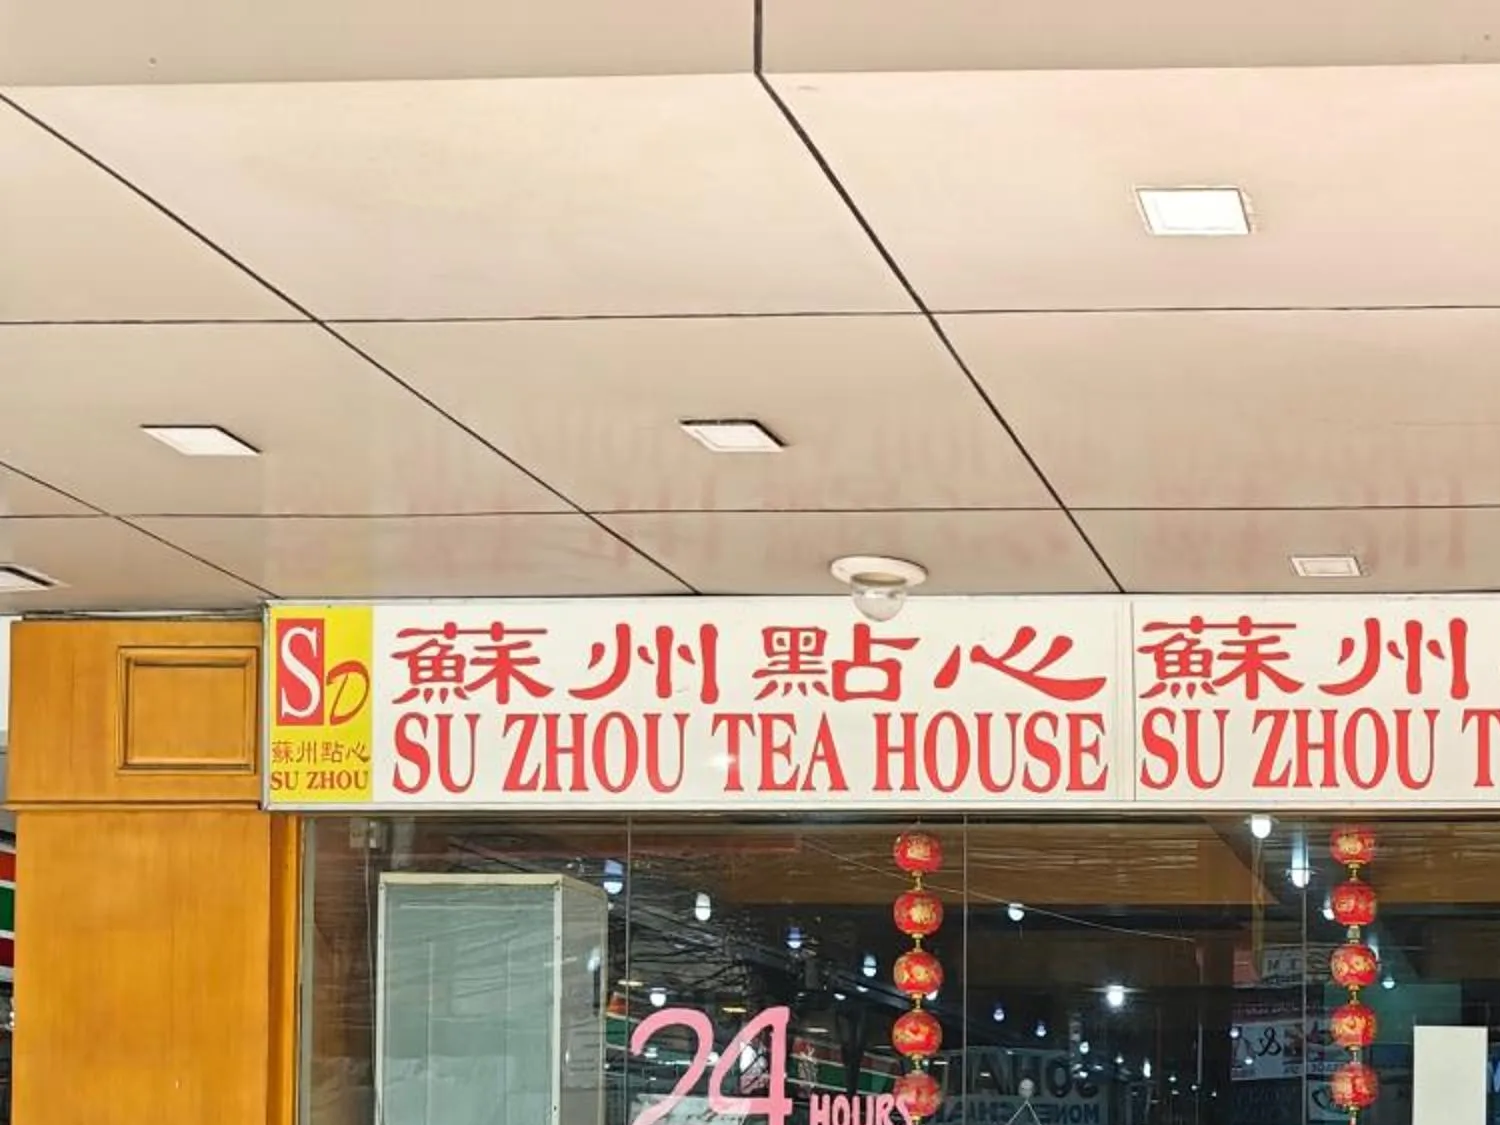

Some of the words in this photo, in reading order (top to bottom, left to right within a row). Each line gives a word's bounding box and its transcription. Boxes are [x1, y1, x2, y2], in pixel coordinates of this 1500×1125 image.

[392, 621, 1107, 705] 蘇州點心
[270, 770, 299, 791] SU
[306, 770, 369, 790] ZHOU
[271, 739, 371, 765] 蘇州點心
[392, 712, 481, 795] SU
[502, 711, 690, 794] ZHOU
[710, 712, 848, 793] TEA
[873, 710, 1109, 794] HOUSE
[1139, 707, 1228, 790] SU
[1251, 706, 1440, 790] ZHOU
